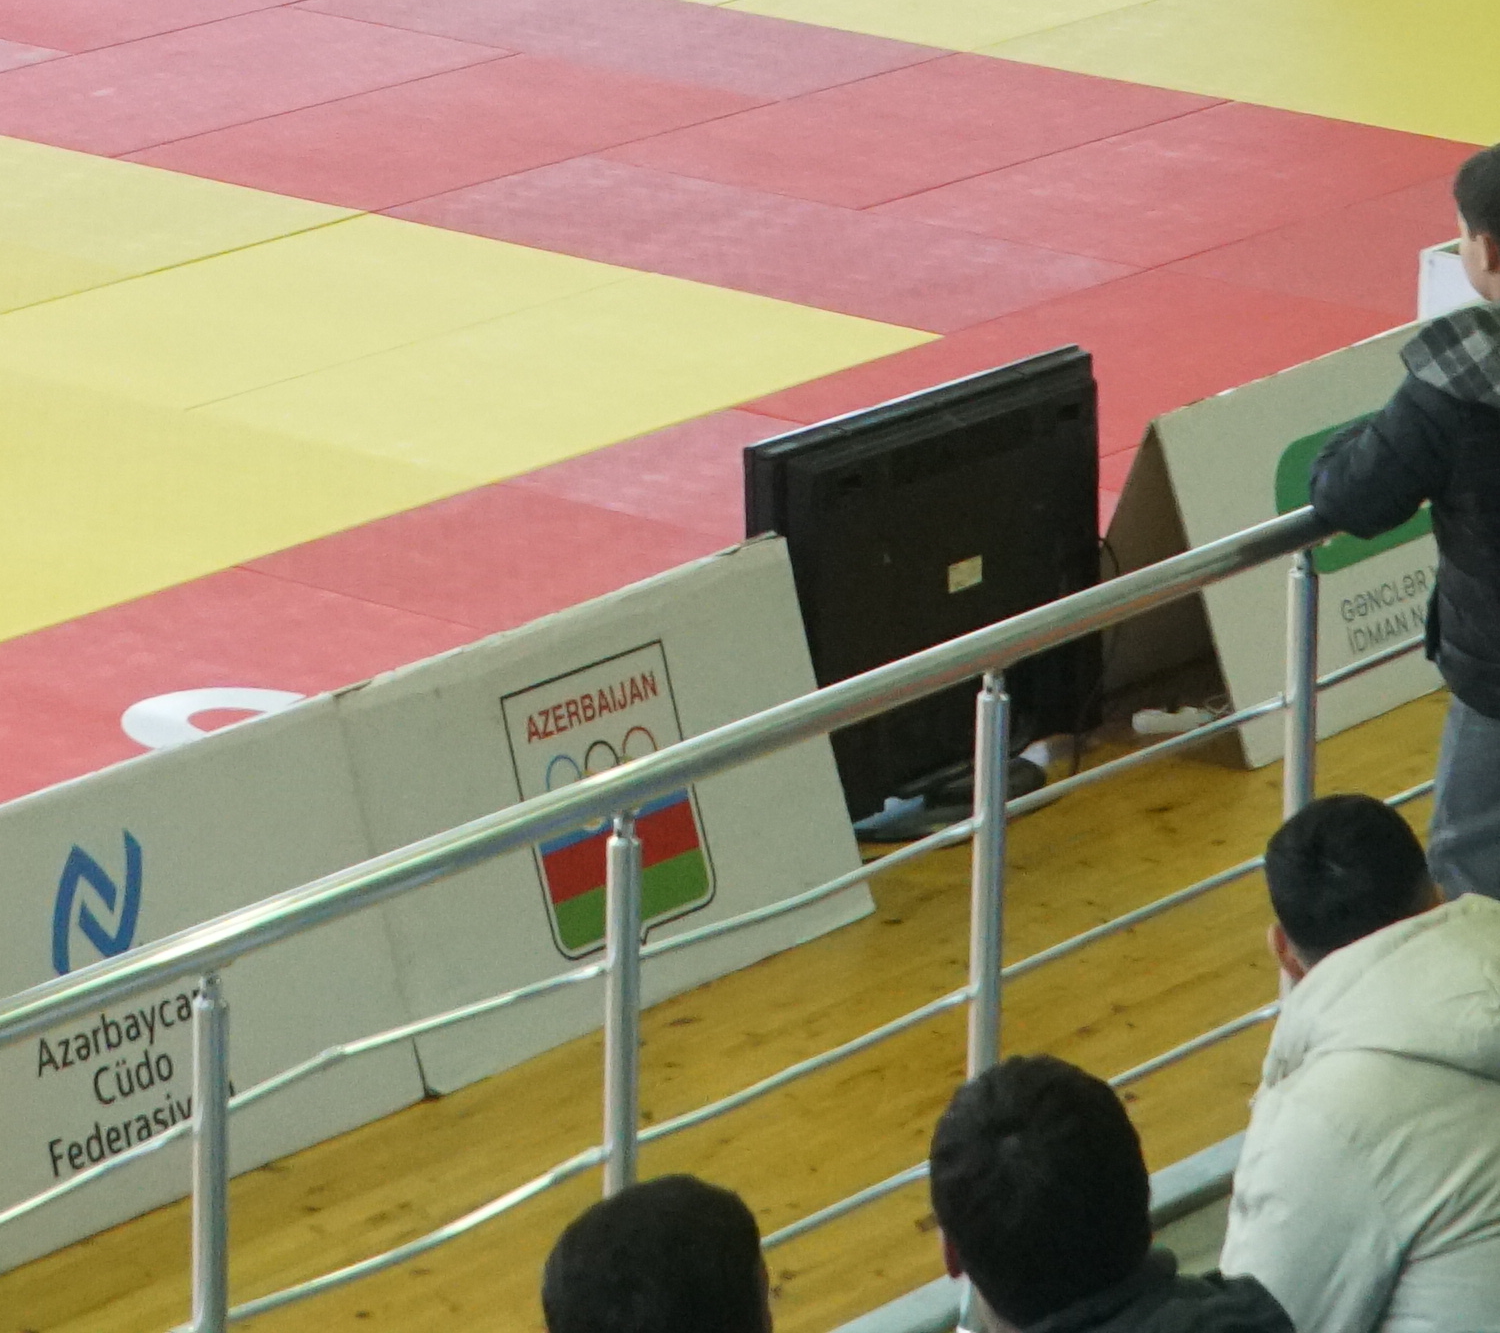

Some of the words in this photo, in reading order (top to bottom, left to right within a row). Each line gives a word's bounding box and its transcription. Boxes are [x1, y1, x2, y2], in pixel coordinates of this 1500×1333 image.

[1340, 569, 1429, 623] GƏNCLƏR
[526, 670, 658, 745] AZERBAIJAN
[93, 1049, 173, 1105] Cüdo
